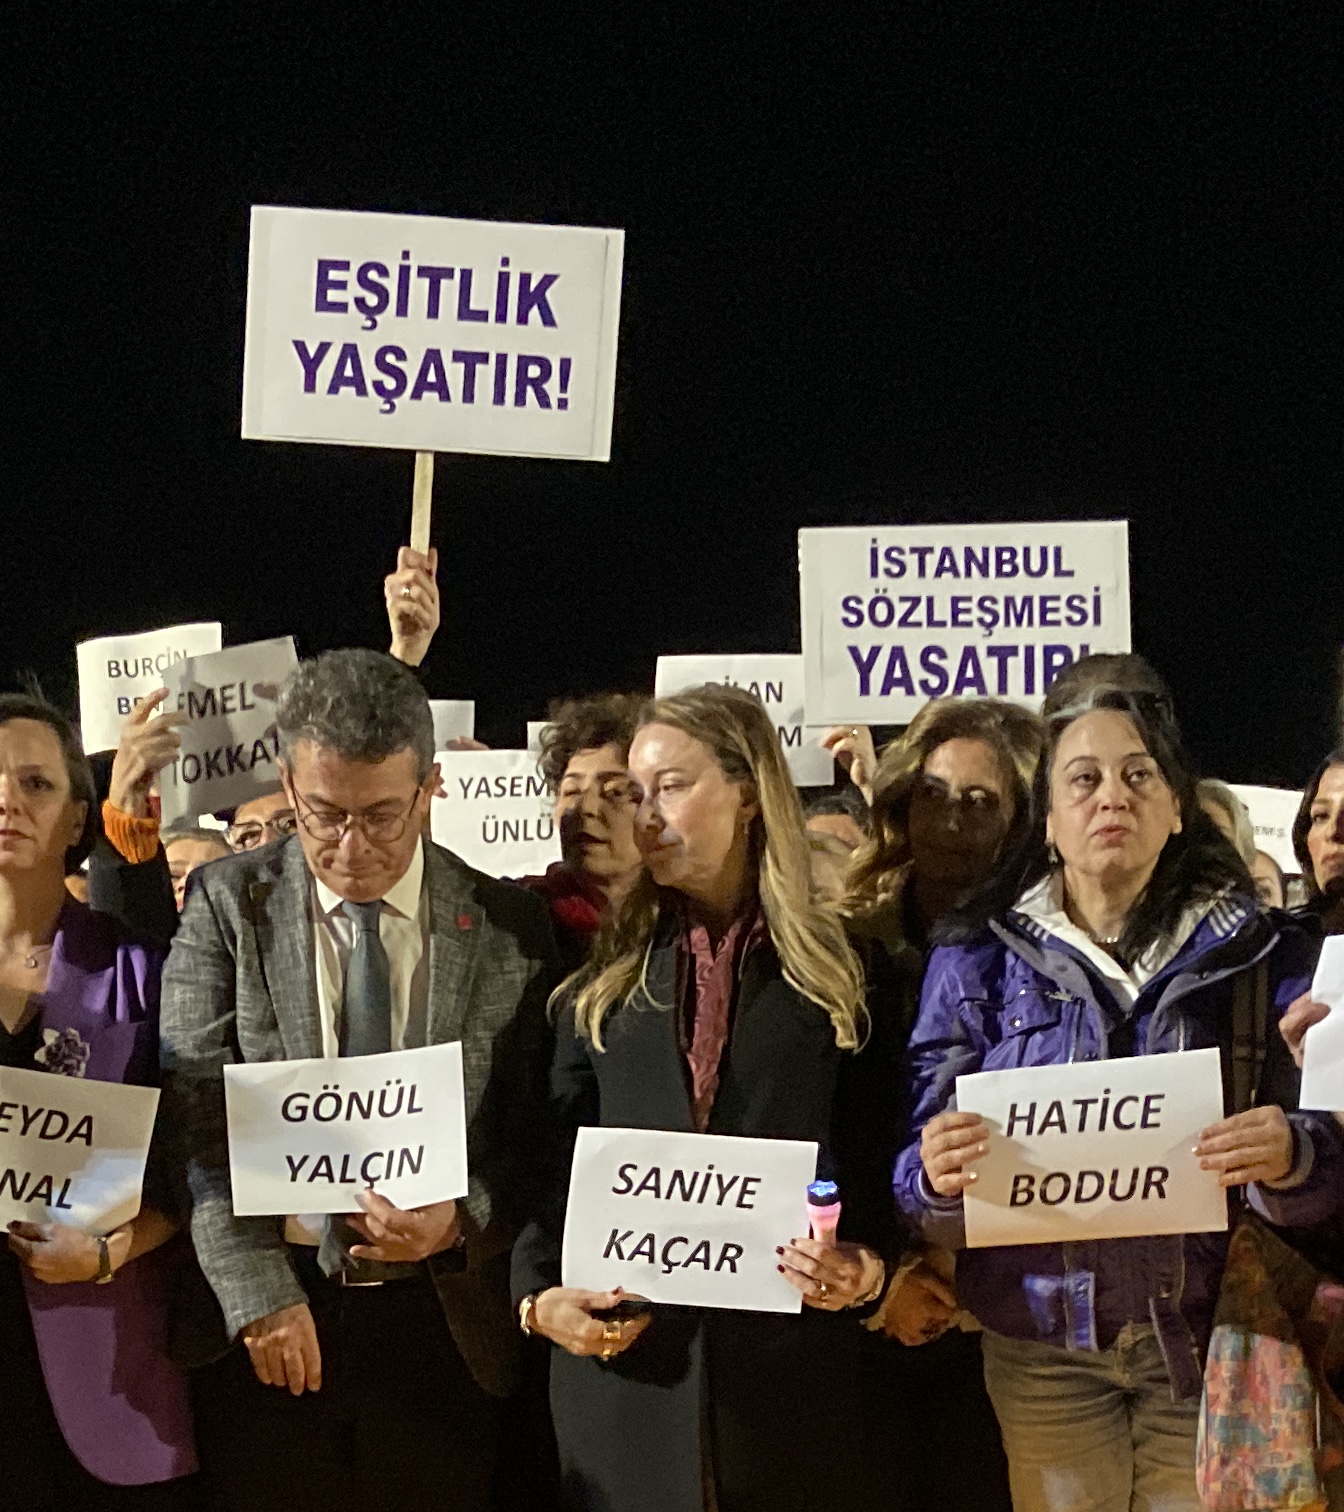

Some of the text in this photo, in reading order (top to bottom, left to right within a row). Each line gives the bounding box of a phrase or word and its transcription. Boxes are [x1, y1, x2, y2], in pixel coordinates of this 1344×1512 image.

[313, 250, 561, 331] EŞİTLİK
[292, 339, 572, 414] YAŞATIR!
[869, 538, 1075, 580] İSTANBUL
[841, 586, 1102, 637] SÖZLEŞMESİ
[482, 813, 554, 844] ÜNLÜ
[281, 1079, 424, 1124] GÖNÜL
[1006, 1087, 1166, 1139] HATİCE
[285, 1145, 425, 1190] YALÇIN
[612, 1162, 762, 1210] SANİYE
[1009, 1165, 1170, 1209] BODUR
[603, 1228, 744, 1275] KAÇAR
